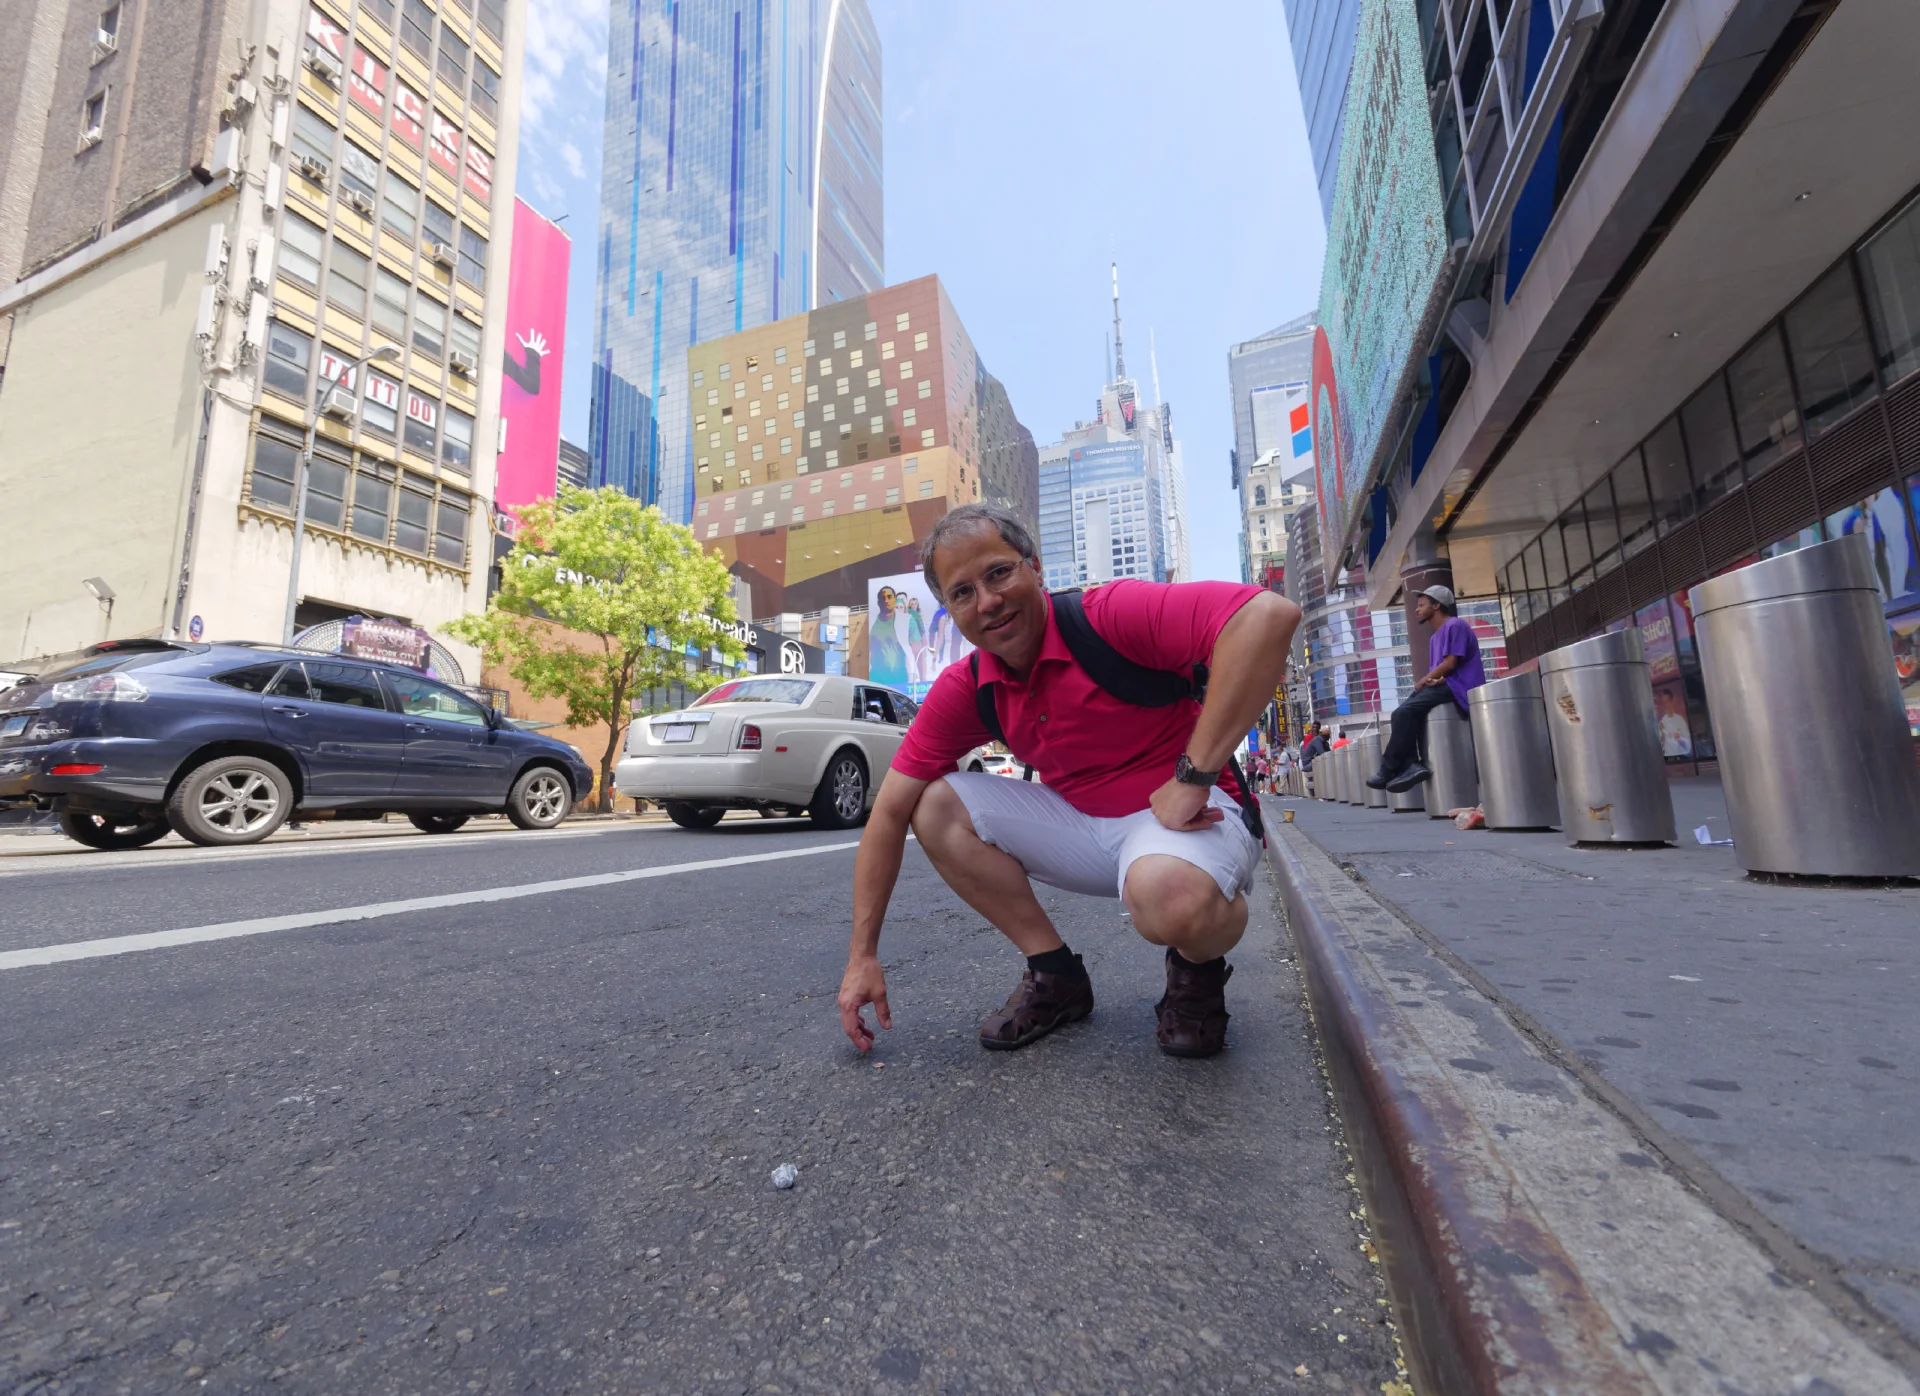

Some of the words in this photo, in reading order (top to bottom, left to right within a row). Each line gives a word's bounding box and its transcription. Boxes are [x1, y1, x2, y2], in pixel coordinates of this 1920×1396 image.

[306, 8, 491, 179] KICKS
[322, 353, 432, 423] TATTOO
[357, 644, 374, 653] NEW
[377, 646, 398, 657] YORK
[400, 652, 417, 661] CITY
[1641, 616, 1671, 643] SHOP
